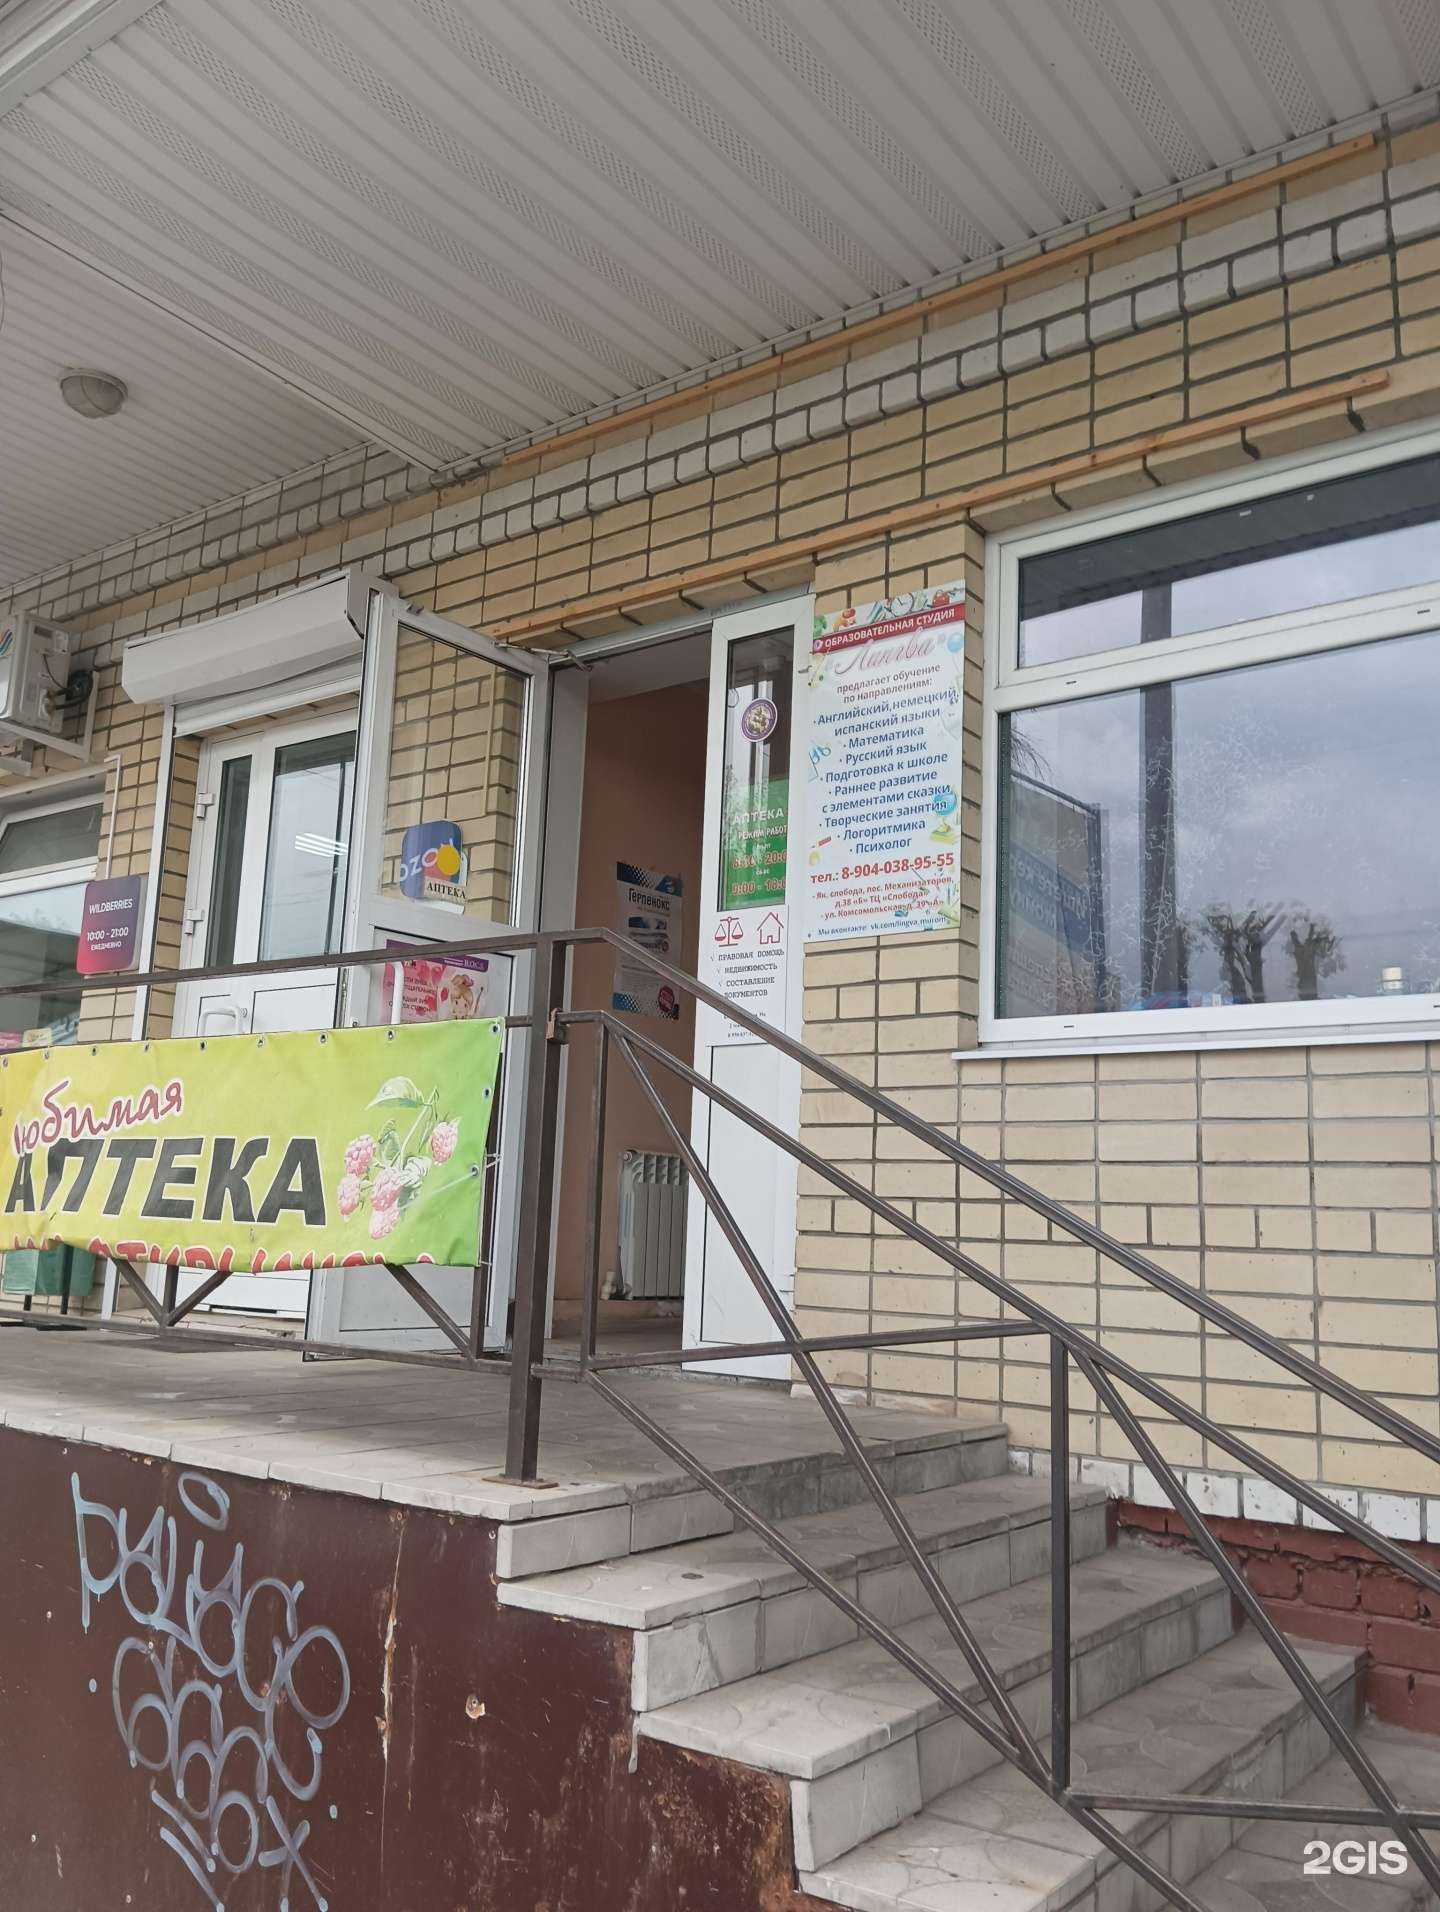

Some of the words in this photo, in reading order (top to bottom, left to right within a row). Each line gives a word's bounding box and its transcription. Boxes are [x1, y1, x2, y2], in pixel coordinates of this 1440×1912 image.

[825, 619, 914, 647] ОБРАЗОВАТЕЛЬНАЯ
[916, 609, 955, 625] СТУДИЯ
[837, 675, 891, 694] предлагает
[893, 664, 941, 682] обучение
[843, 695, 855, 704] по
[834, 712, 898, 736] испанский
[901, 707, 940, 722] языки
[849, 726, 924, 749] Математика
[845, 748, 893, 766] Русский
[896, 741, 927, 755] язык
[826, 763, 894, 783] Подготовка
[897, 760, 904, 770] к
[907, 753, 948, 768] школе
[834, 781, 876, 796] Раннее
[879, 770, 938, 791] развитие
[822, 804, 828, 813] с
[830, 792, 904, 813] элементами
[907, 784, 950, 800] сказки
[733, 808, 785, 825] АПТЕКА
[824, 808, 893, 829] Творческие
[897, 800, 947, 816] занятия
[766, 825, 788, 837] РАБОТ
[843, 819, 926, 842] Логоритмика
[856, 837, 912, 854] Психолог
[810, 871, 839, 884] тел.:
[841, 852, 954, 880] 8-904-038-95-55
[427, 882, 466, 899] АПТЕКА
[89, 898, 133, 915] WILDBERRIES
[87, 929, 106, 942] 10:00
[718, 951, 753, 961] ПРАВОВАЯ
[757, 948, 785, 958] ПОМОЩЬ
[724, 962, 778, 974] НЕДВИЖИМОСТЬ
[726, 976, 775, 987] СОСТАВЛЕНИЕ
[5, 1137, 326, 1226] АПТЕКА
